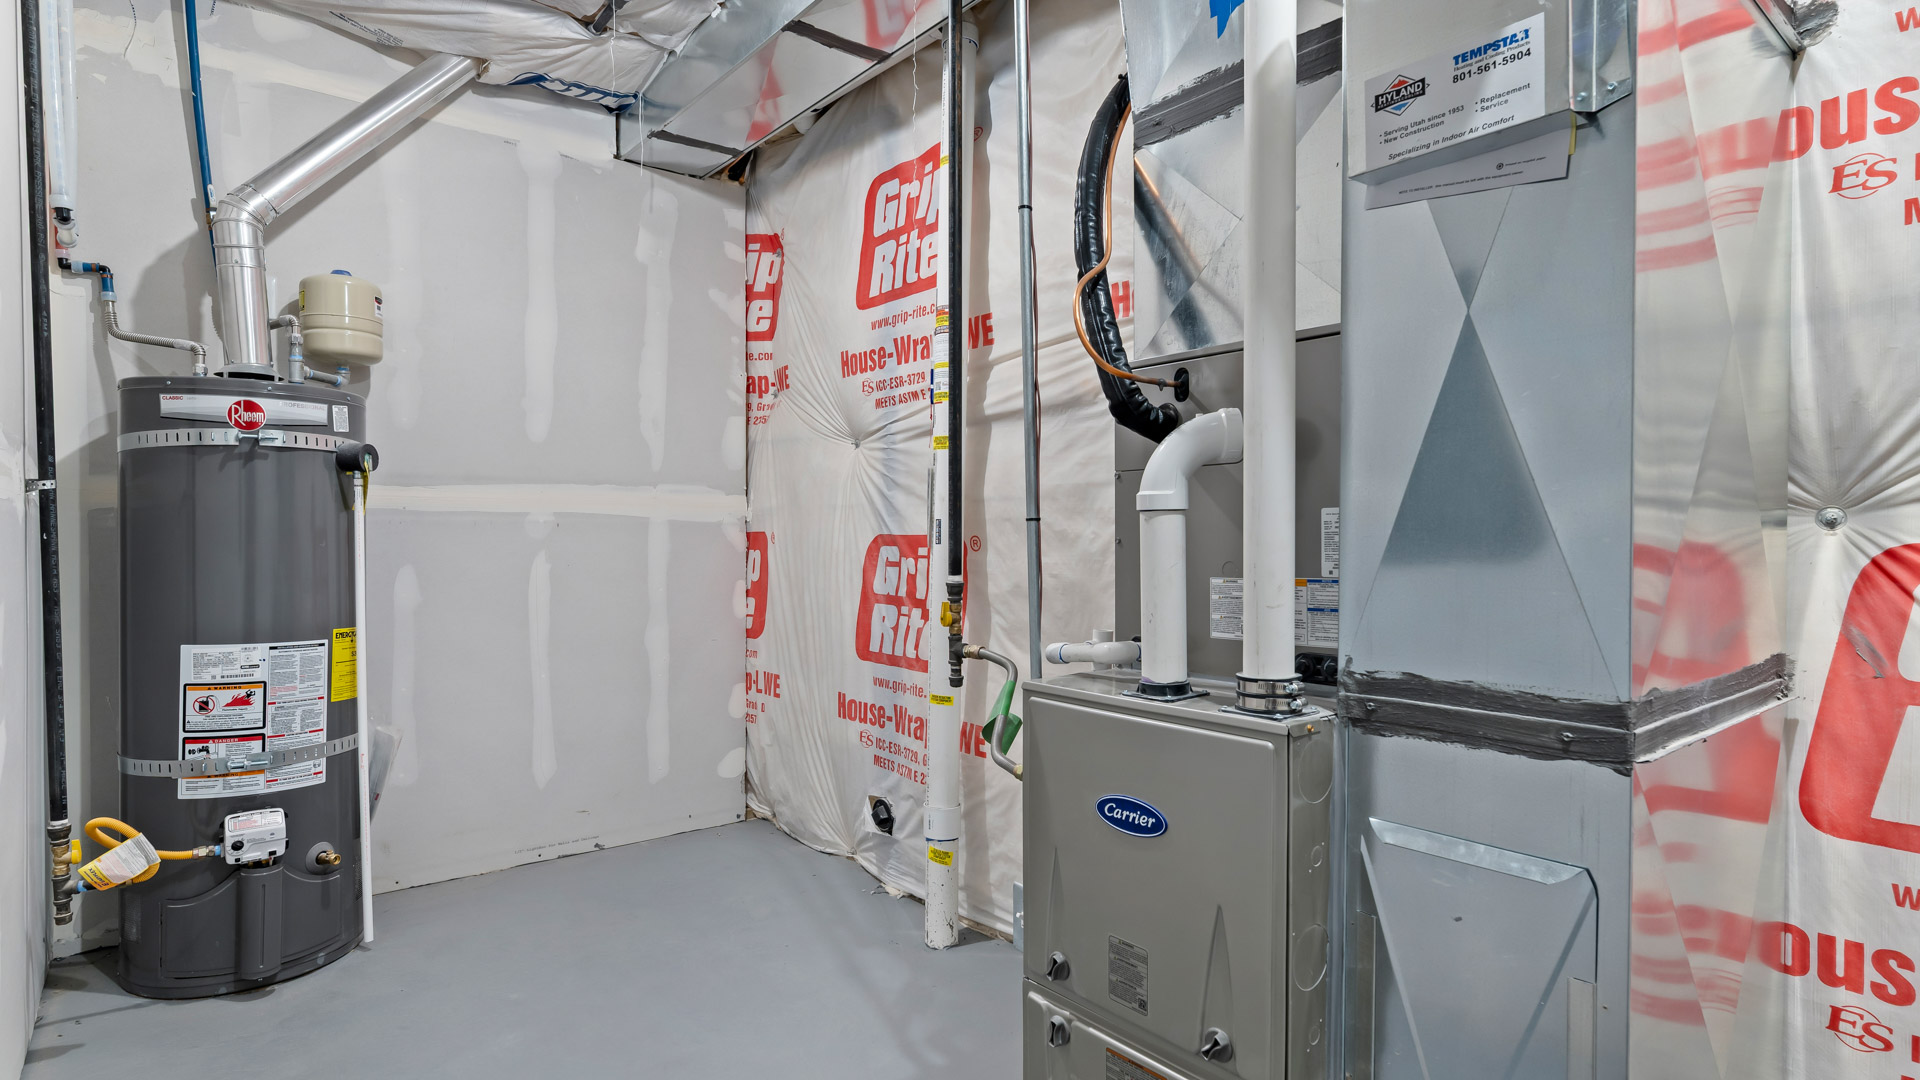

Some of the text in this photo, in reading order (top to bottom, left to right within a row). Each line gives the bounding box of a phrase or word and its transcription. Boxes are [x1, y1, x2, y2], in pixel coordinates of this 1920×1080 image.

[1453, 28, 1530, 66] TEMPSTAR
[1453, 40, 1531, 72] Heating and Cooling Products
[1452, 47, 1532, 84] 801-561-5904
[1378, 81, 1423, 105] HYLAND
[1480, 82, 1531, 105] Replacement
[1480, 98, 1509, 113] Service
[1383, 104, 1465, 138] Serving Utah since 1953
[1383, 121, 1445, 145] New Construction
[1388, 114, 1515, 161] Specializing in Indoor Air Comfort
[868, 228, 938, 299] Rite
[871, 303, 935, 331] www.grip-rite.c
[231, 400, 264, 426] Rheem
[875, 395, 896, 410] MEETS
[898, 390, 920, 405] ASTM
[921, 389, 927, 400] E
[873, 545, 929, 600] Gri
[872, 676, 927, 698] www.grip-rite.
[873, 754, 895, 772] MEETS
[896, 762, 912, 780] ASTM
[913, 770, 918, 783] E
[1104, 802, 1156, 829] Carrier
